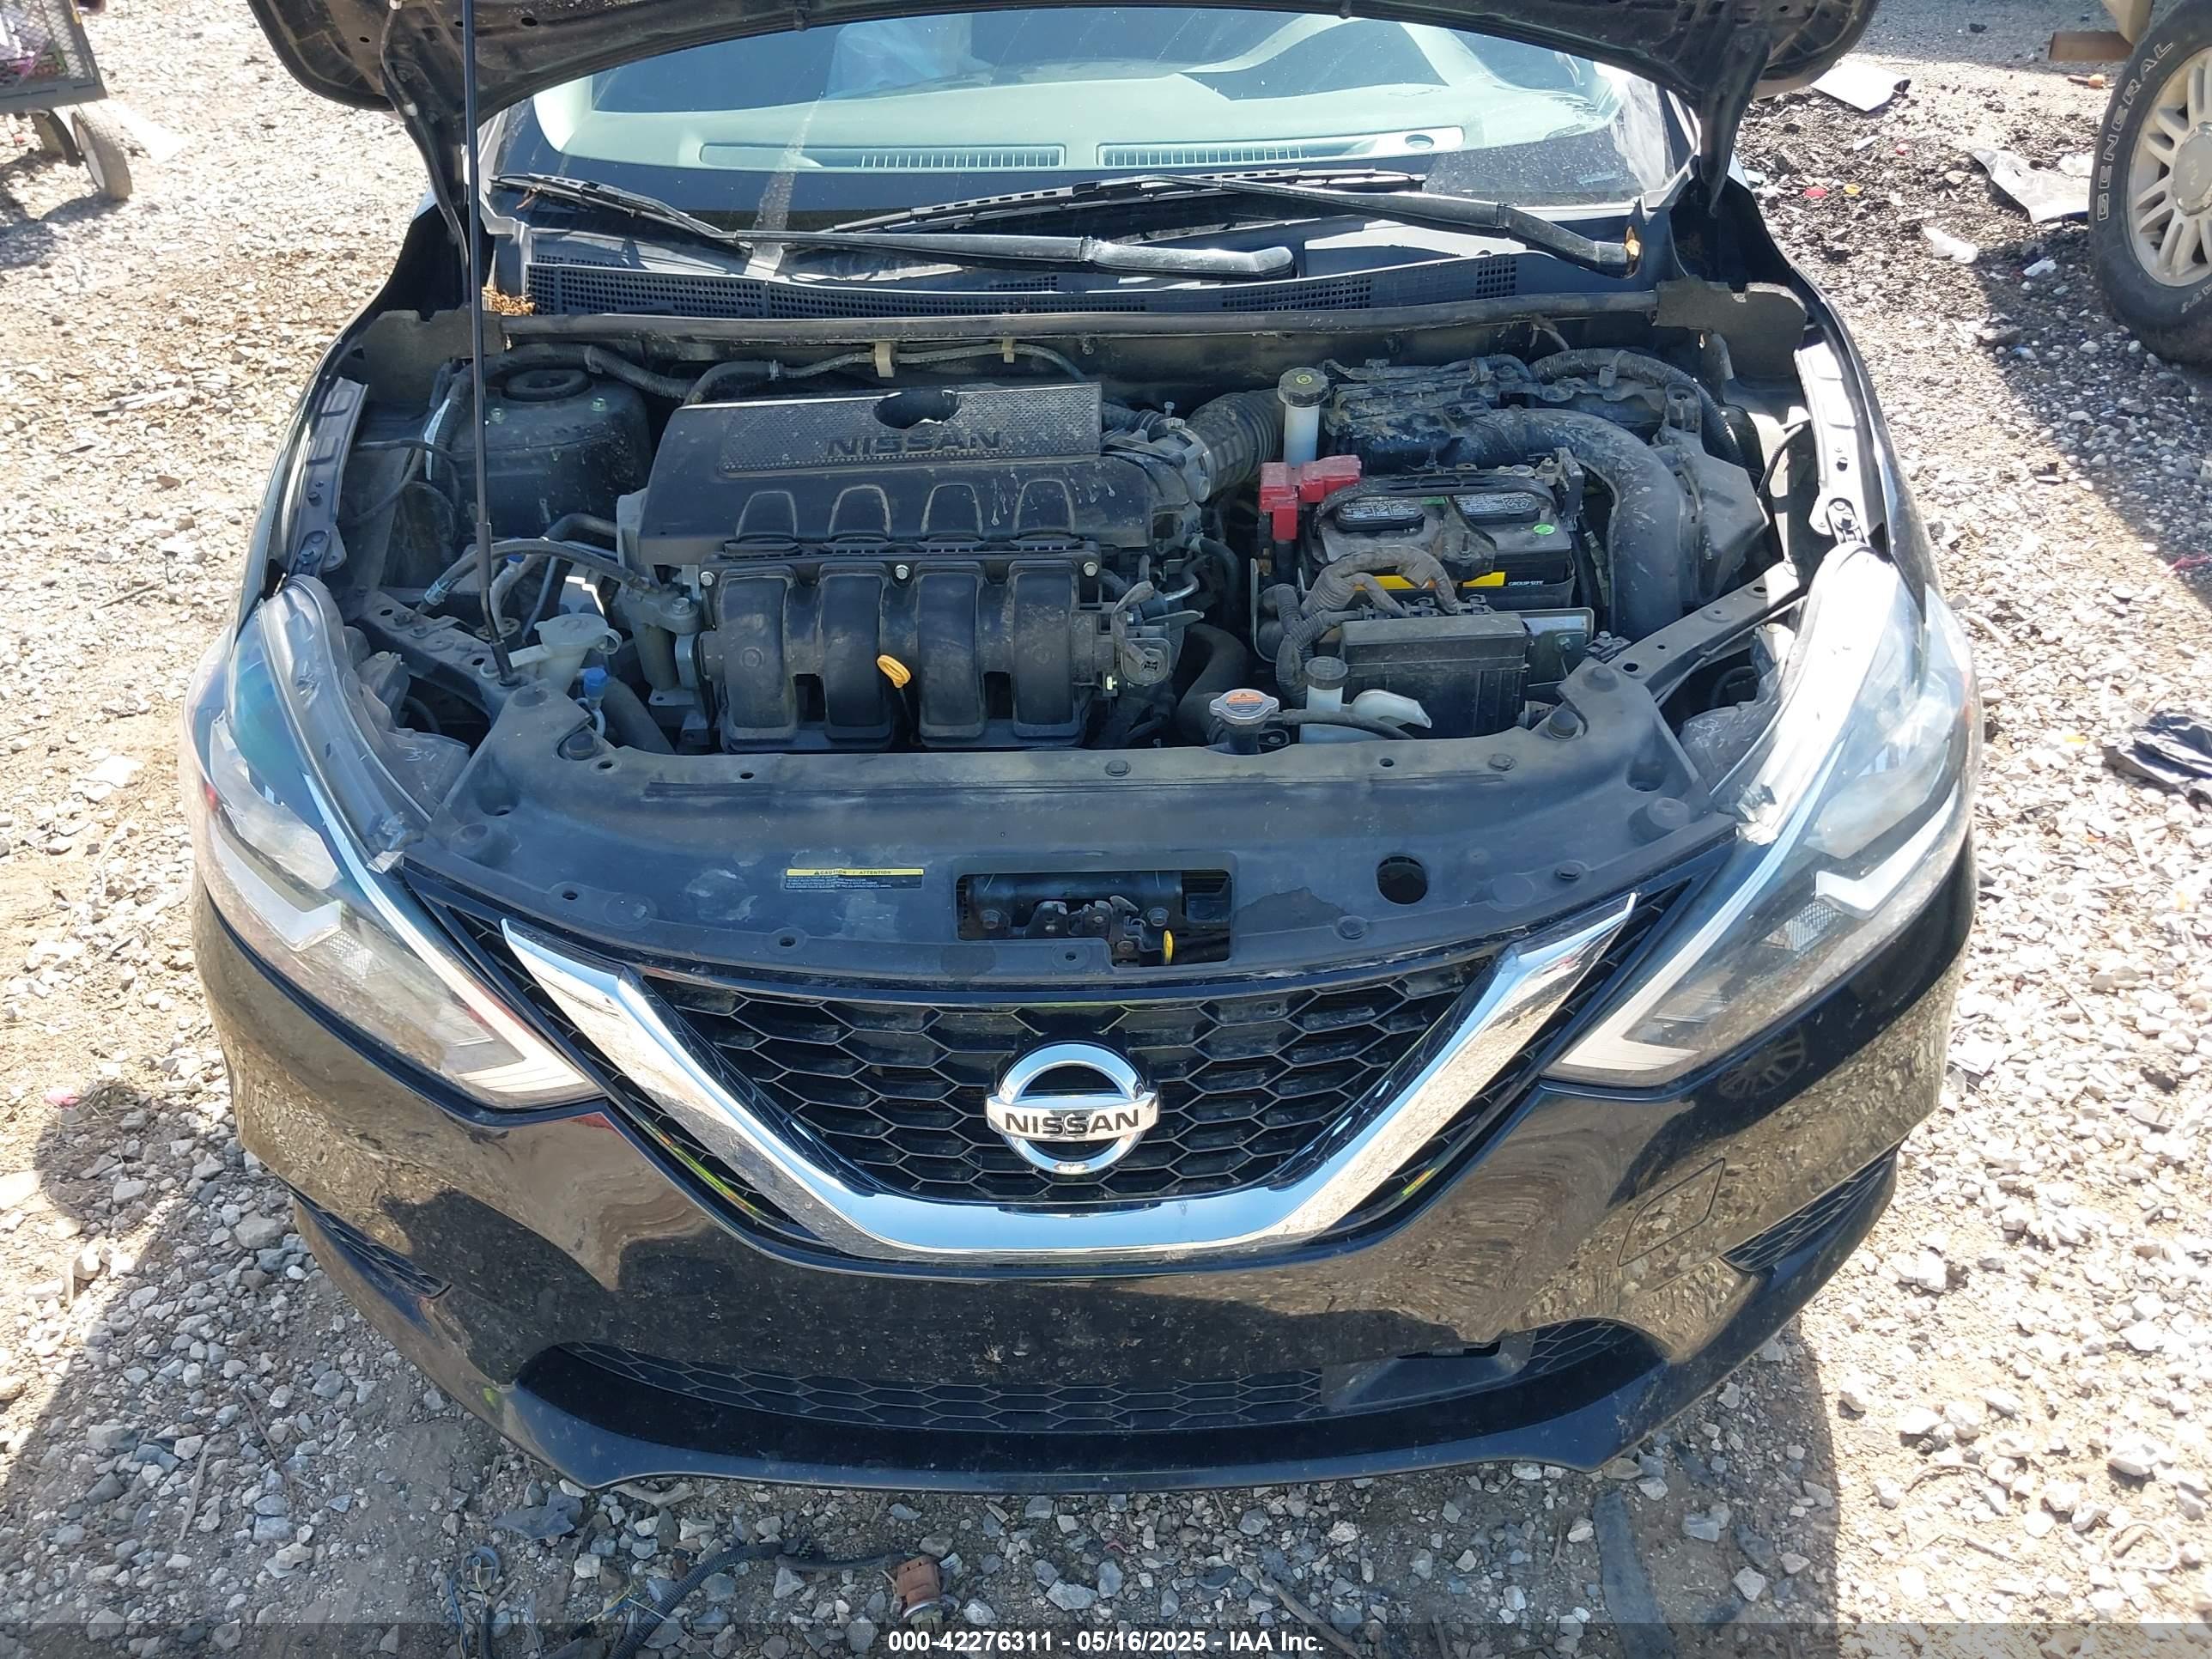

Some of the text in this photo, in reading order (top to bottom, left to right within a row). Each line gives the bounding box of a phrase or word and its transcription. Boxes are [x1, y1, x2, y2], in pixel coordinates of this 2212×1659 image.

[2097, 40, 2174, 222] GENERAL
[826, 432, 1001, 457] NISSAN
[1005, 1109, 1139, 1136] NISSAN
